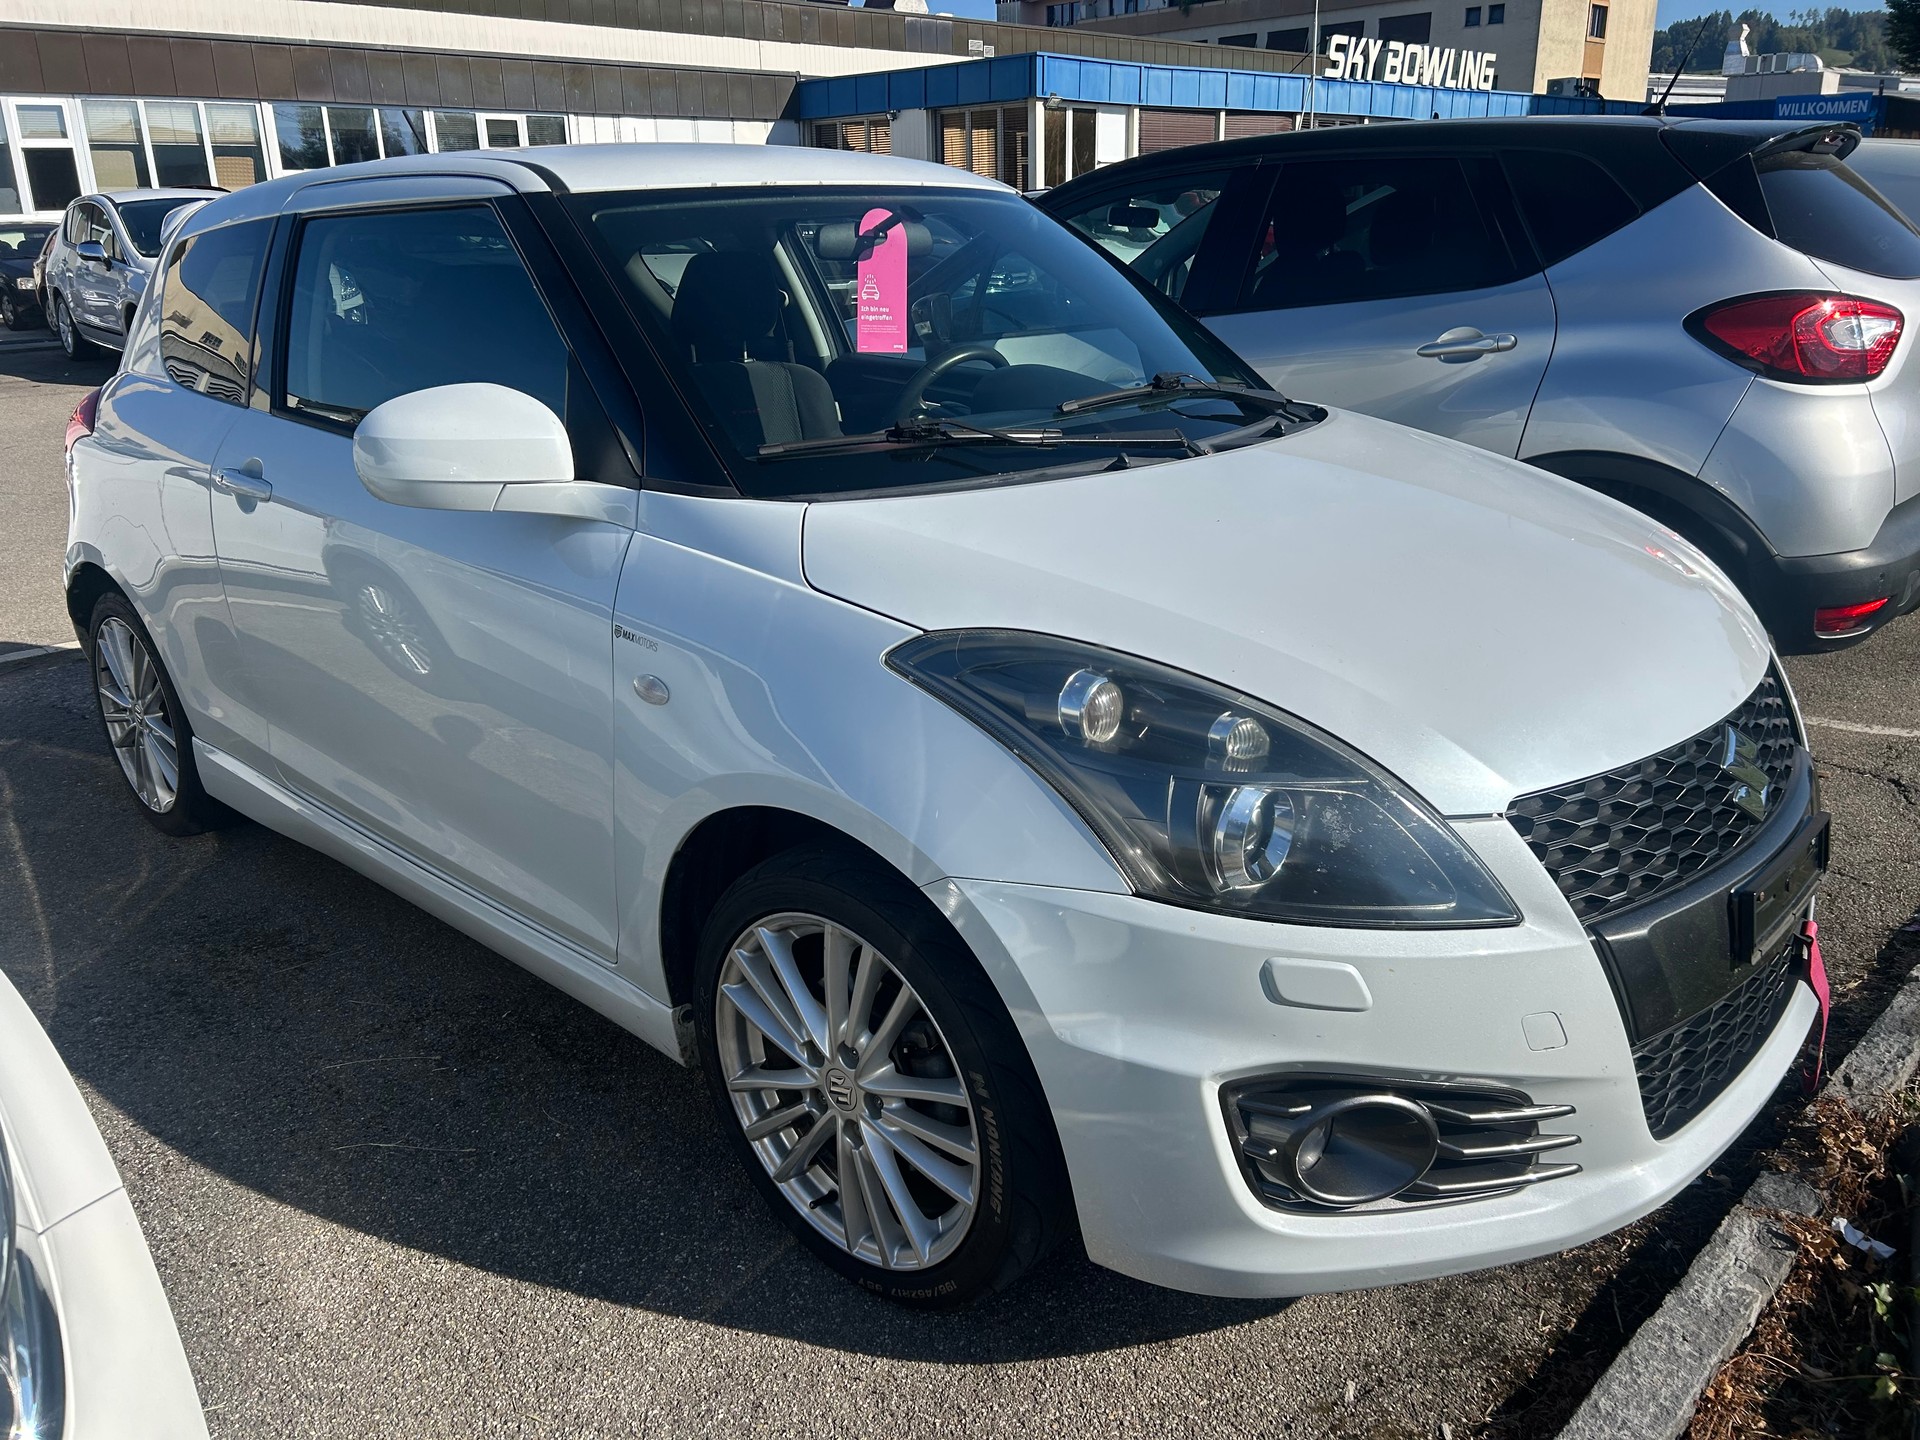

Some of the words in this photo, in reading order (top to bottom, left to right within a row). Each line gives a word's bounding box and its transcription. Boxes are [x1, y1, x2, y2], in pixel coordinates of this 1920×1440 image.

[1324, 34, 1383, 81] SKY
[1384, 41, 1497, 90] BOWLING
[1778, 99, 1869, 116] WILLKOMMEN
[981, 1105, 1004, 1215] NANKANG
